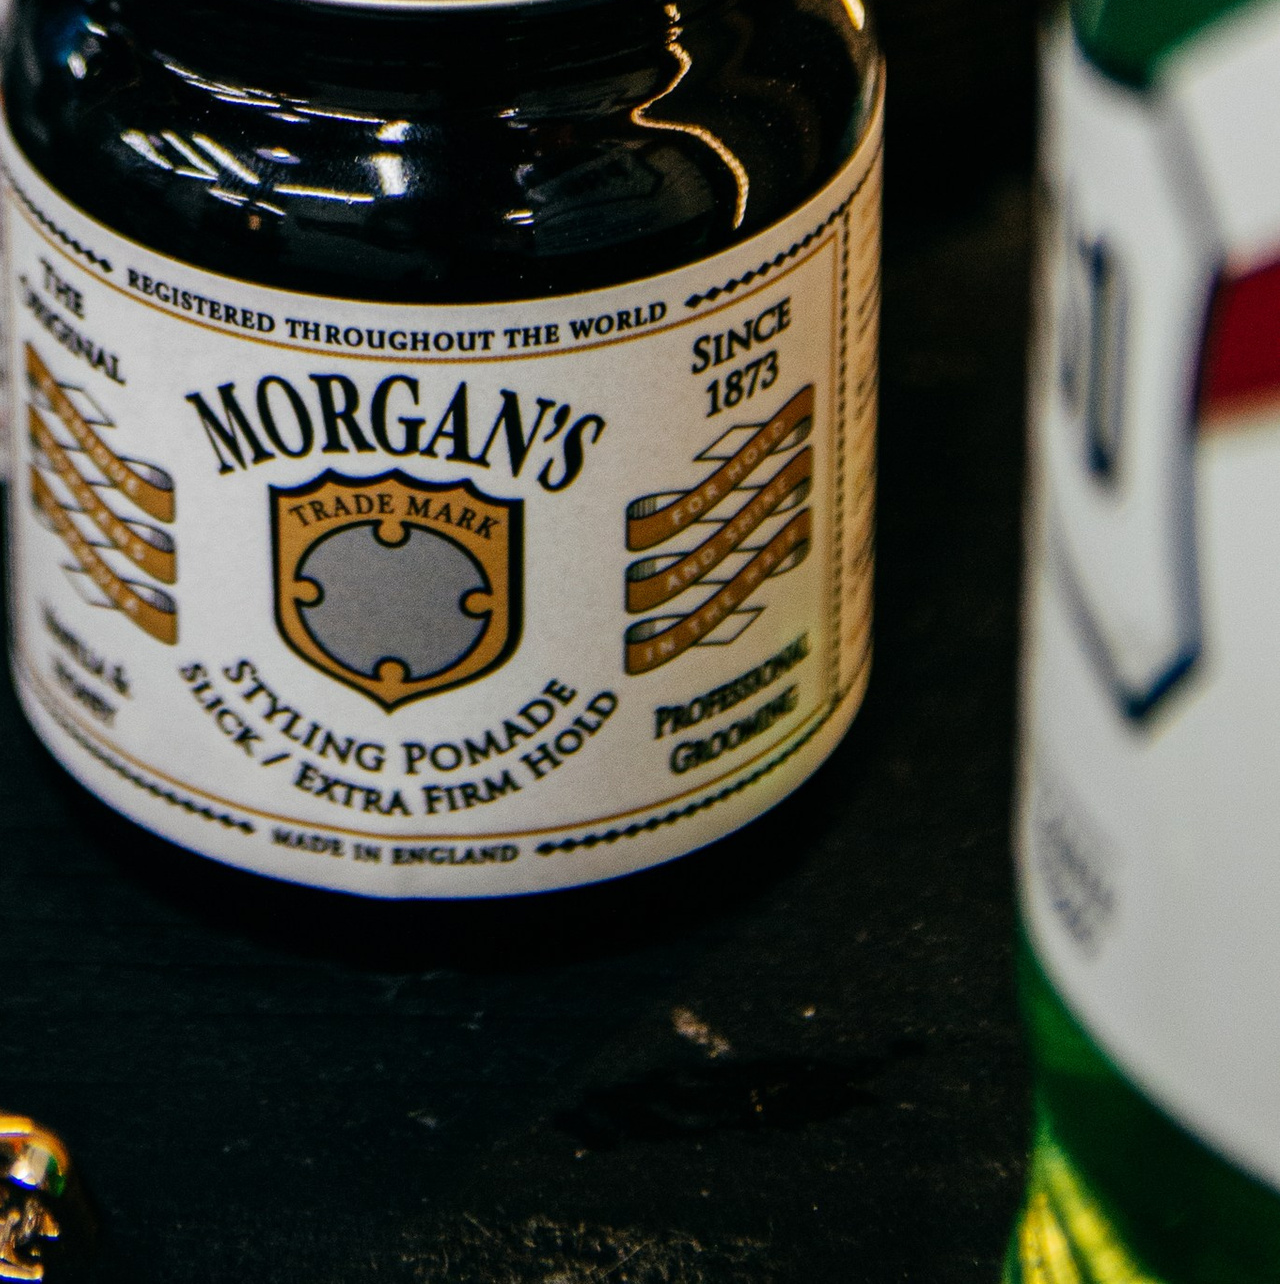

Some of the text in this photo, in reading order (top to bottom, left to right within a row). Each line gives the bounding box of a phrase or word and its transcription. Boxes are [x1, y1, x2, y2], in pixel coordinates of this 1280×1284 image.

[127, 267, 667, 352] REGISTERED THROUGHOUT THE WORLD
[691, 296, 792, 374] SINCE
[706, 350, 779, 418] 1873
[185, 373, 606, 492] MORGAN'S
[672, 420, 786, 525] FOR HOLD
[288, 493, 500, 543] TRADE MARK
[667, 548, 717, 590] AND
[646, 639, 676, 661] IN
[179, 662, 264, 756] SLICK
[294, 761, 413, 816] EXTRA
[422, 770, 522, 816] FIRM
[521, 690, 620, 780] HOLD
[223, 658, 578, 774] STYLING POMADE
[271, 827, 520, 866] MADE IN ENGLAND
